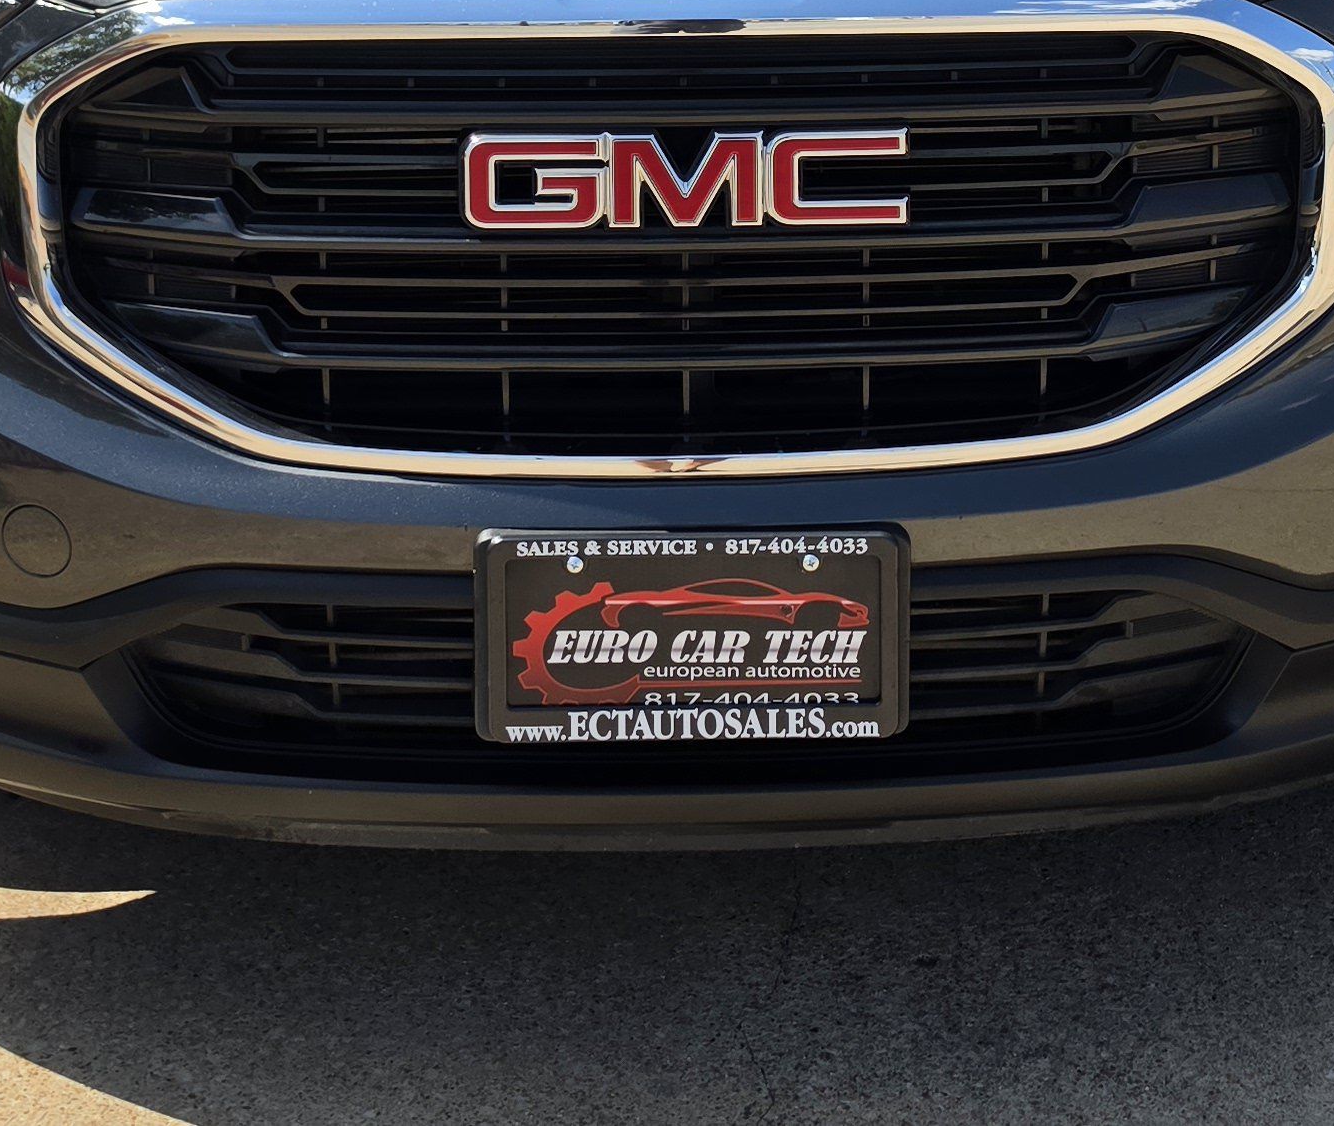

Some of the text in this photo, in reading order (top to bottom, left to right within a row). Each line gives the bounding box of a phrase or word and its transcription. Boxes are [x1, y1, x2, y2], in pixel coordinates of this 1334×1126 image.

[464, 126, 909, 229] GMC
[516, 538, 869, 557] SALES & SERVICE 817-404-4033
[547, 630, 868, 664] EURO CAR TECH
[643, 662, 861, 681] european automotive
[505, 708, 880, 743] www.ECTAUTOSALES.com
